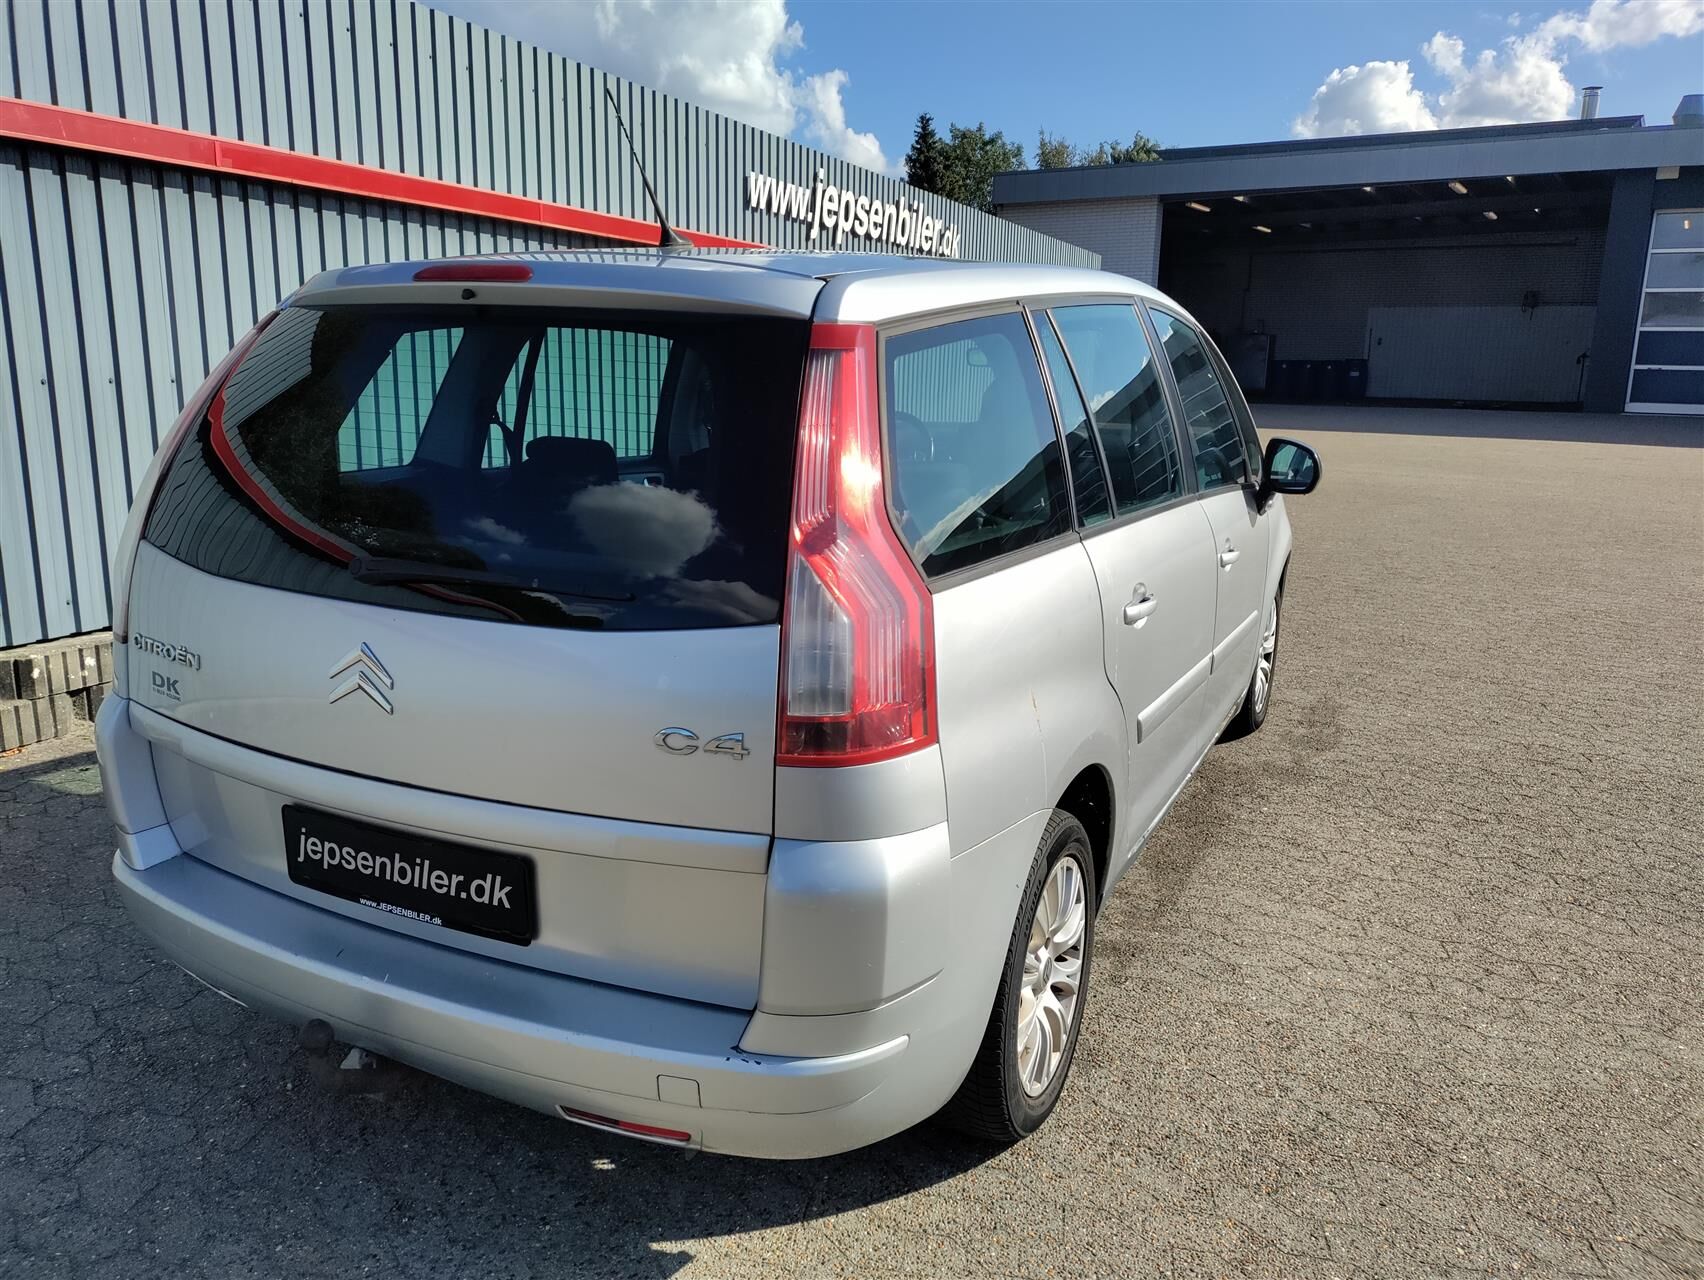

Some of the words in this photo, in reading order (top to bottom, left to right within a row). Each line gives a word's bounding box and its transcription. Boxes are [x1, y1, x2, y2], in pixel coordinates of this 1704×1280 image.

[750, 168, 960, 258] www.jepsenbiler.dk
[133, 632, 201, 671] CITROËN
[151, 671, 181, 696] DK
[654, 726, 751, 761] C4
[297, 827, 513, 909] jepsenbiler.dk
[359, 897, 442, 926] www.JEPSENBILER.dk
